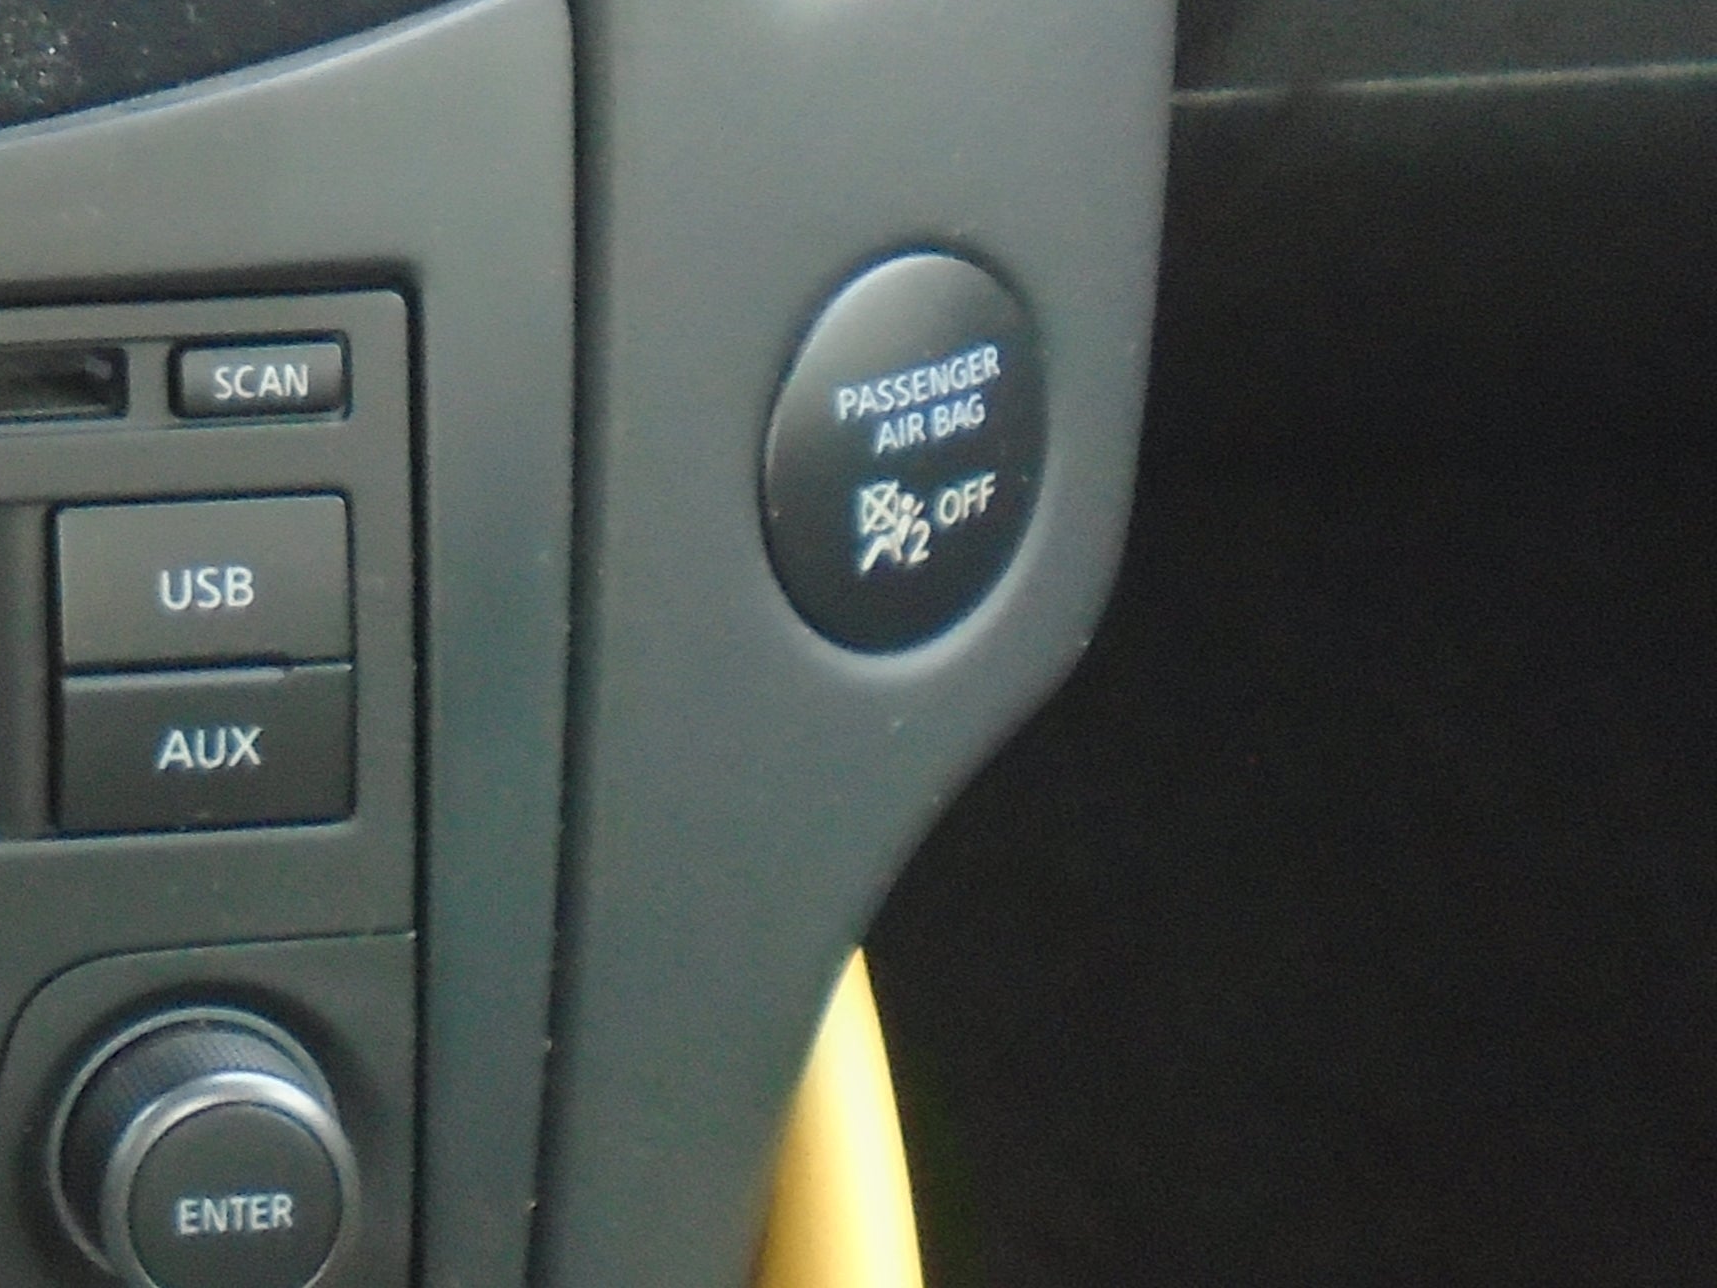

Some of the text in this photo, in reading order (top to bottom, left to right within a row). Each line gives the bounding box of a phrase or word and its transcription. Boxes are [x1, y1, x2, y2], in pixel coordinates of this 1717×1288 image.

[213, 363, 309, 400] SCAN
[837, 344, 1002, 422] PASSENGER
[875, 393, 986, 455] AIR BAG
[938, 472, 997, 526] OFF
[159, 566, 255, 611] USB
[156, 726, 264, 770] AUX
[175, 1192, 295, 1237] ENTER
